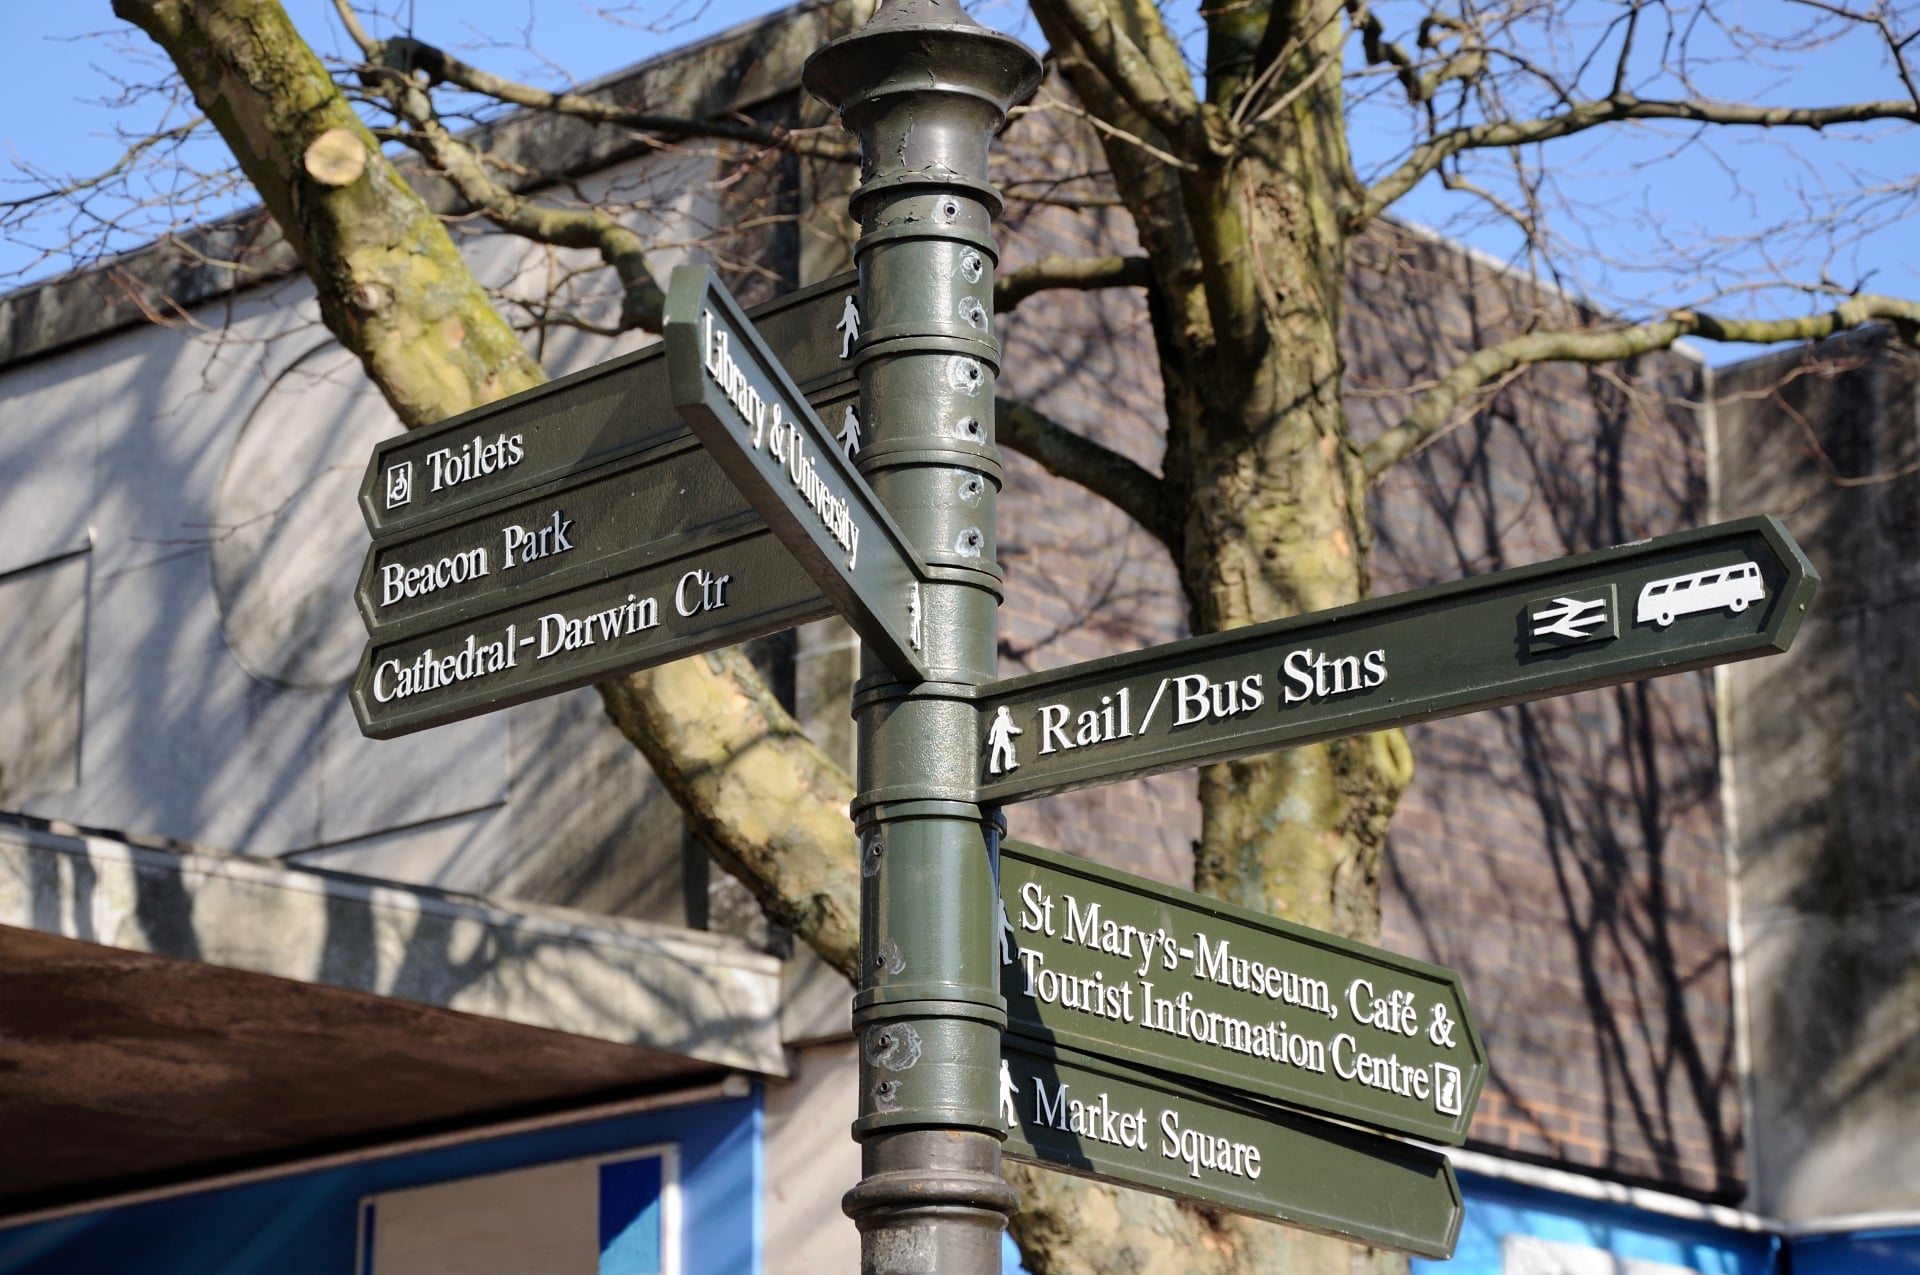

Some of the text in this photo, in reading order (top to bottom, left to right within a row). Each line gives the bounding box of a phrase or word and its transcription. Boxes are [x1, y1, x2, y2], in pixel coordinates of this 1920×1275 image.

[426, 432, 524, 492] Toilets
[703, 308, 860, 571] Library & University
[380, 511, 575, 607] Beacon Park
[373, 569, 730, 703] Cathedral-Darwin Ctr
[1282, 647, 1387, 703] Stns
[1017, 947, 1430, 1100] Tourist Information Centre
[1020, 882, 1055, 937] St
[1349, 978, 1419, 1037] Café
[1429, 1002, 1457, 1049] &
[1033, 1076, 1262, 1179] Market Square
